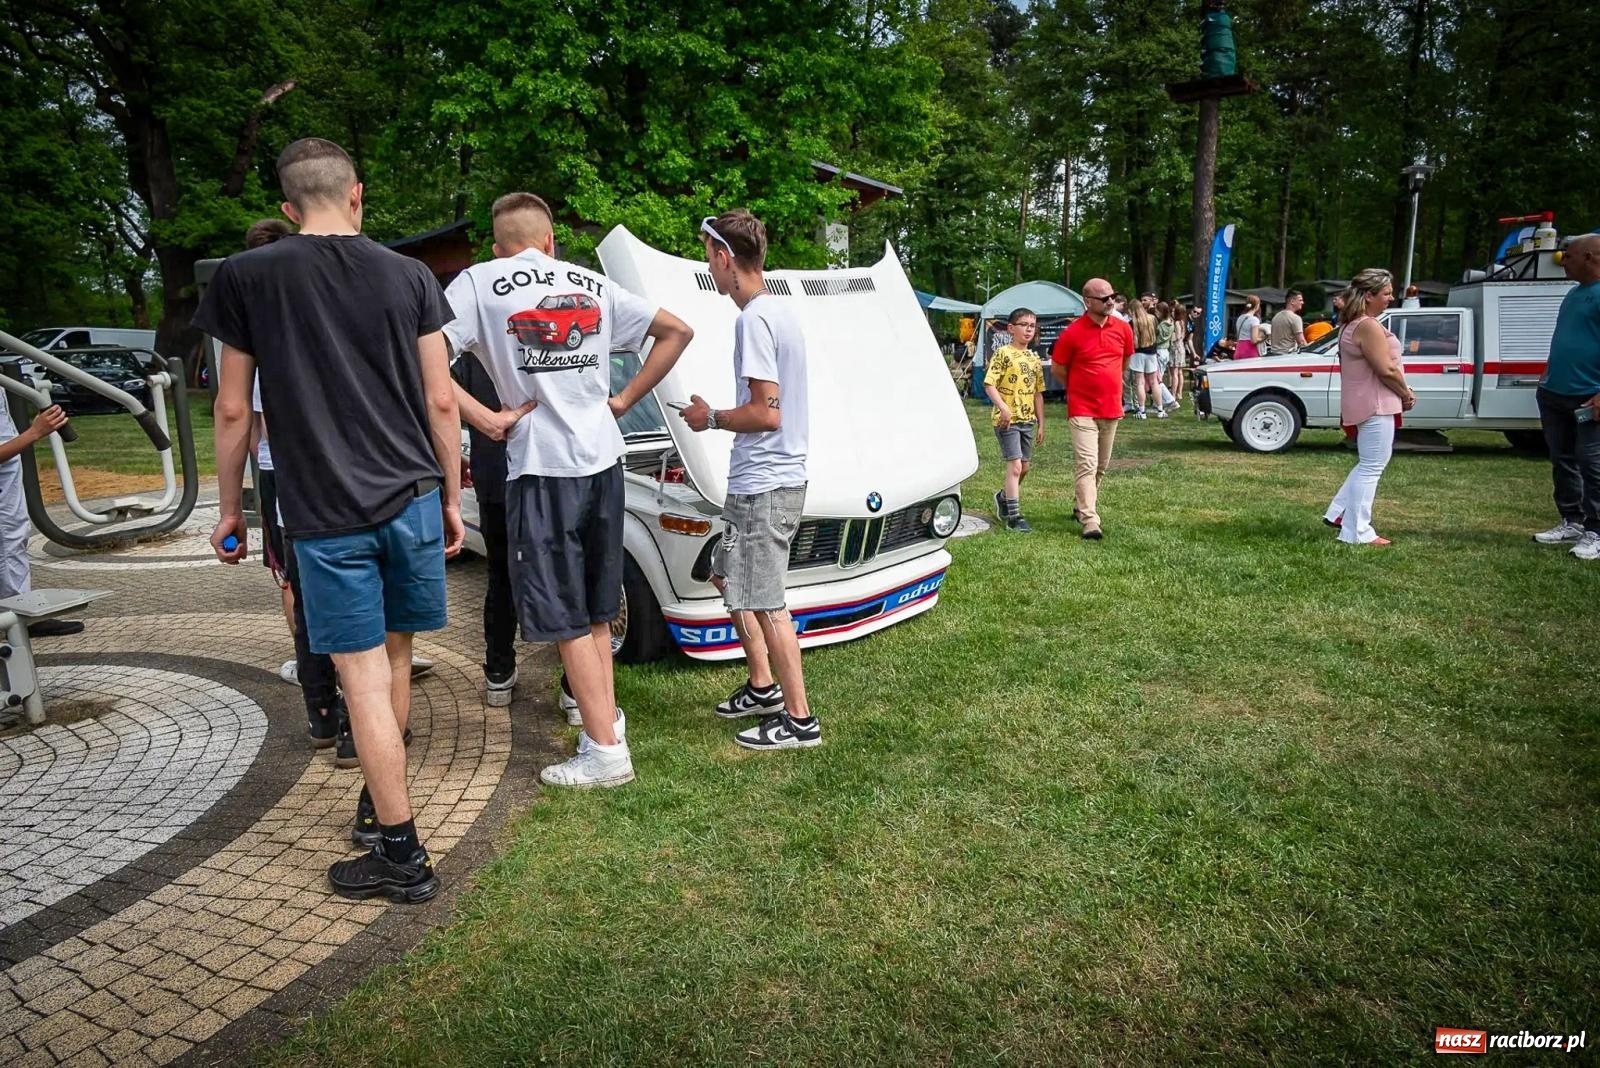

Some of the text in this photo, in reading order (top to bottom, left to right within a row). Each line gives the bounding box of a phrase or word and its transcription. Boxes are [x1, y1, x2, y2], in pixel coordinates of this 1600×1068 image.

[492, 268, 603, 298] GOLF GTI
[518, 347, 599, 373] Volkswage
